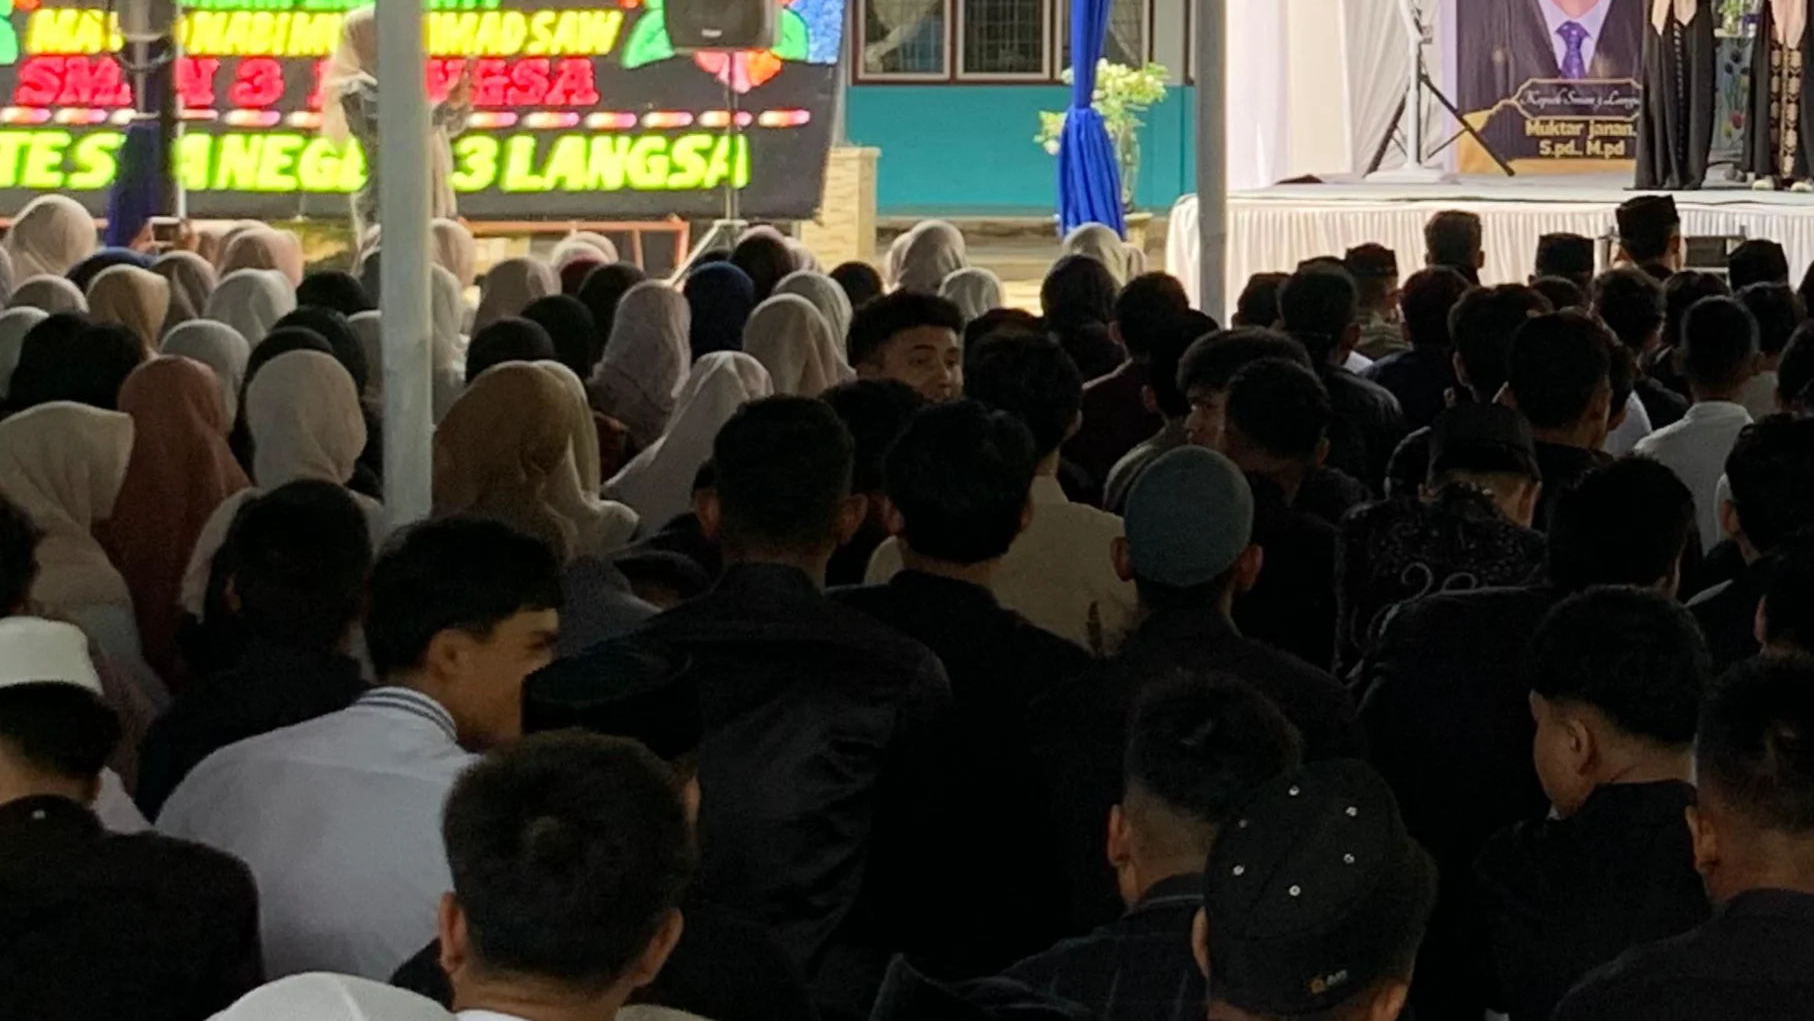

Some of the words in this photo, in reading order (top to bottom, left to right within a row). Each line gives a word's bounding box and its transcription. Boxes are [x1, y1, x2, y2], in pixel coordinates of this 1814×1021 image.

[525, 10, 623, 55] SAW
[14, 56, 218, 106] SMN
[229, 57, 285, 107] 3
[1525, 119, 1584, 136] Muktar
[1586, 140, 1625, 159] M.pd
[449, 133, 499, 192] 3
[502, 133, 748, 192] LANGSA
